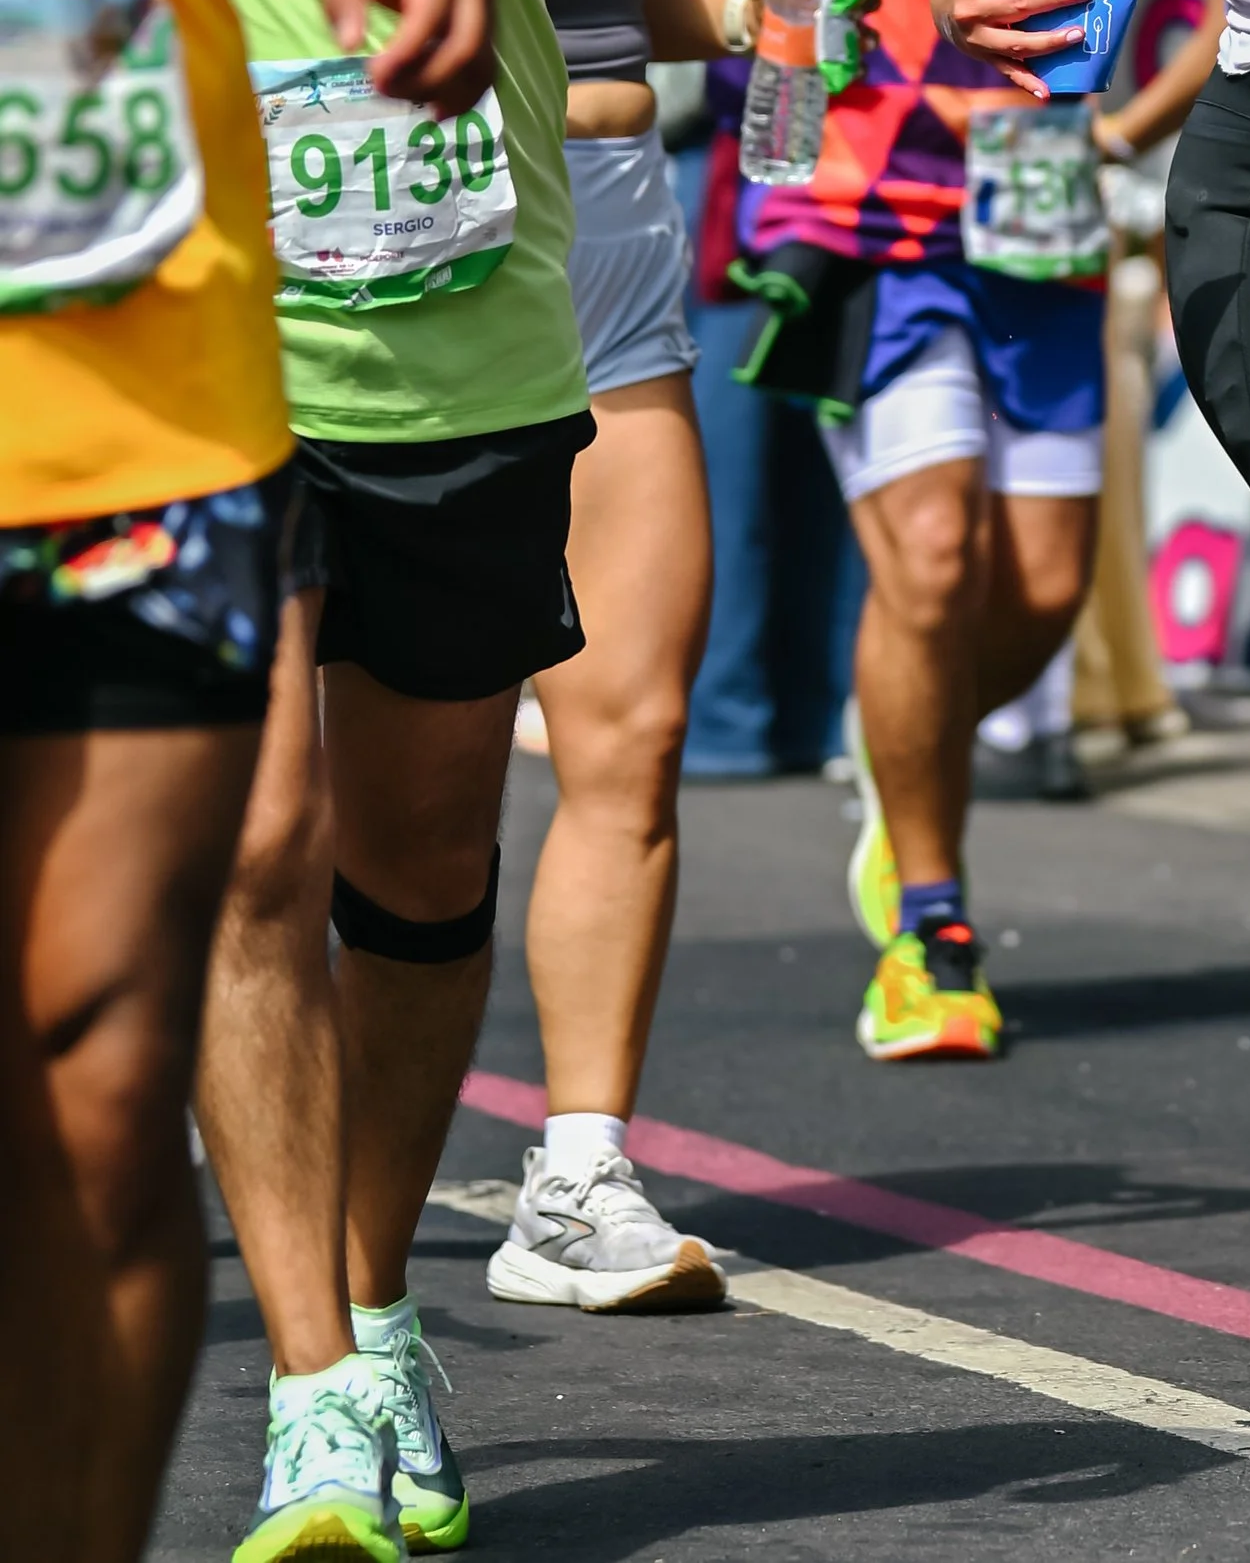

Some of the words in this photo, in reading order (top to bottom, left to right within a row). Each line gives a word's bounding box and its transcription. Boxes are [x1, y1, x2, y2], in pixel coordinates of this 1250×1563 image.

[0, 90, 174, 198] 658
[291, 109, 495, 218] 9130
[373, 216, 435, 237] SERGIO
